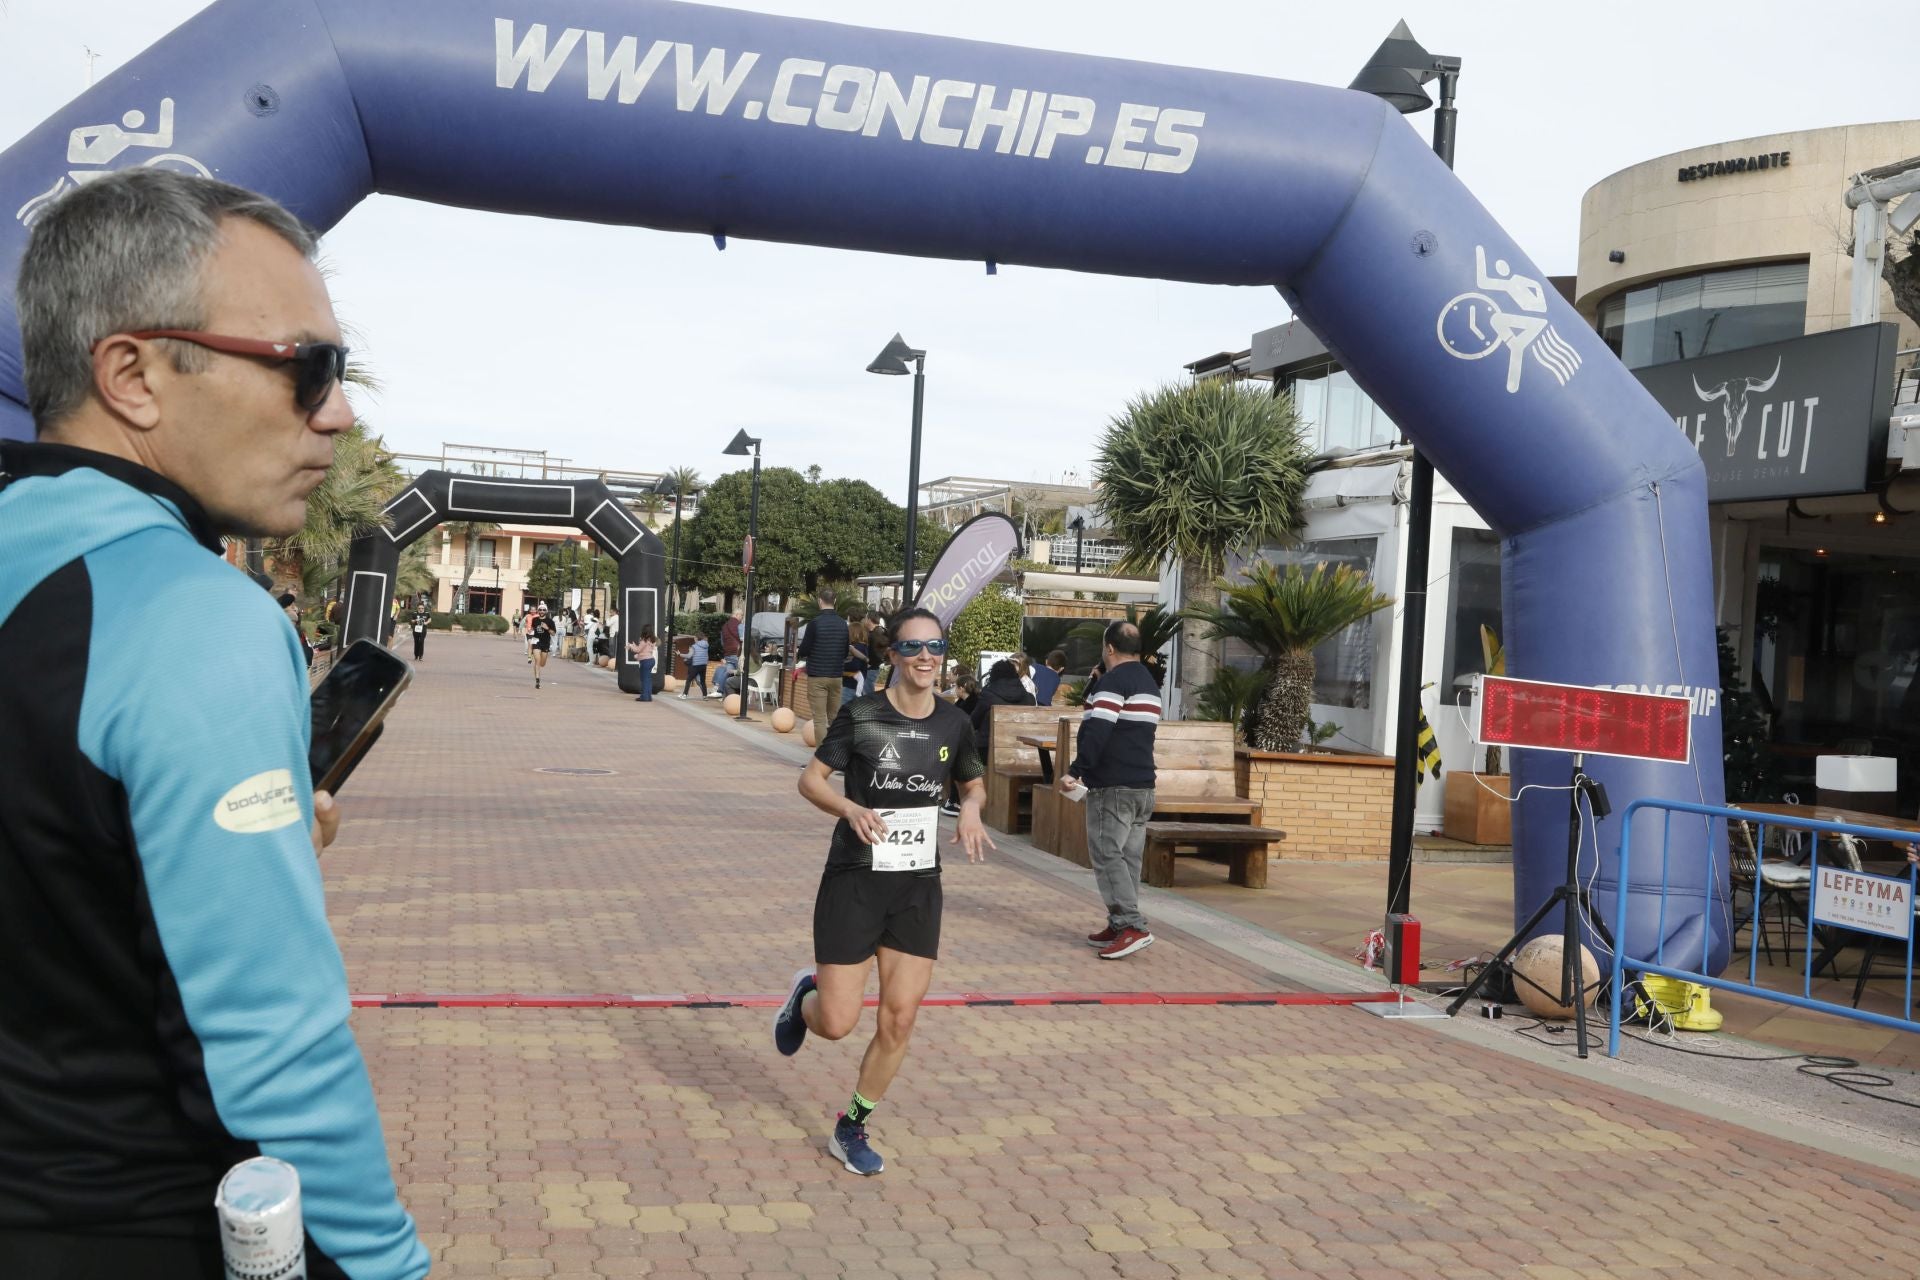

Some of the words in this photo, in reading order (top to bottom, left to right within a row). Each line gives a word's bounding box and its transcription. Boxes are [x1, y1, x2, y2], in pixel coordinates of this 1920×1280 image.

[494, 17, 1206, 174] WWW.CONCHIP.ES
[1677, 151, 1791, 182] RESTAURANTE
[1757, 396, 1820, 474] CUT
[922, 541, 997, 613] Pleamar
[887, 829, 926, 846] 424
[1823, 872, 1904, 903] LEFEYMA
